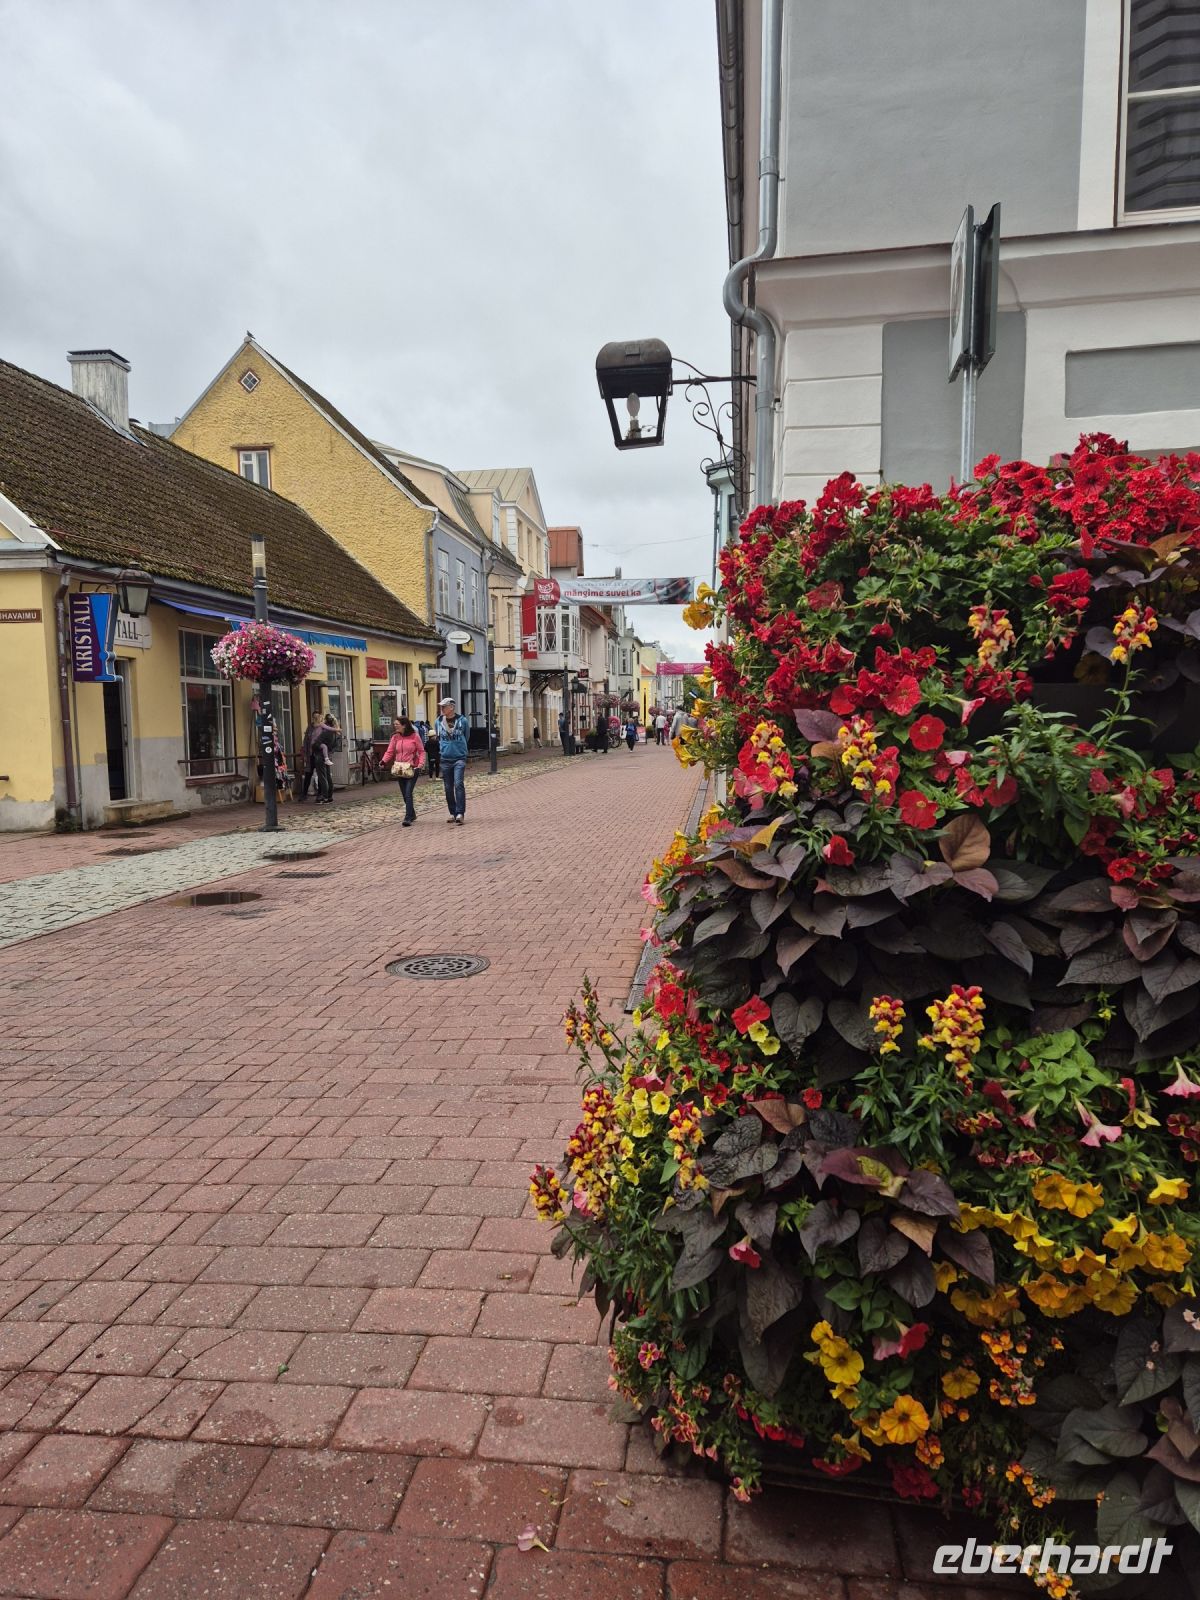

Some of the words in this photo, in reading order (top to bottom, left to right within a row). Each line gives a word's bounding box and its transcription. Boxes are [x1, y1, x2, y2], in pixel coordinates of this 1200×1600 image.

[564, 588, 604, 598] mängime
[631, 588, 642, 597] ka
[0, 612, 37, 620] HAVAIMU
[72, 596, 93, 672] KRISTALL
[116, 619, 139, 640] TALL
